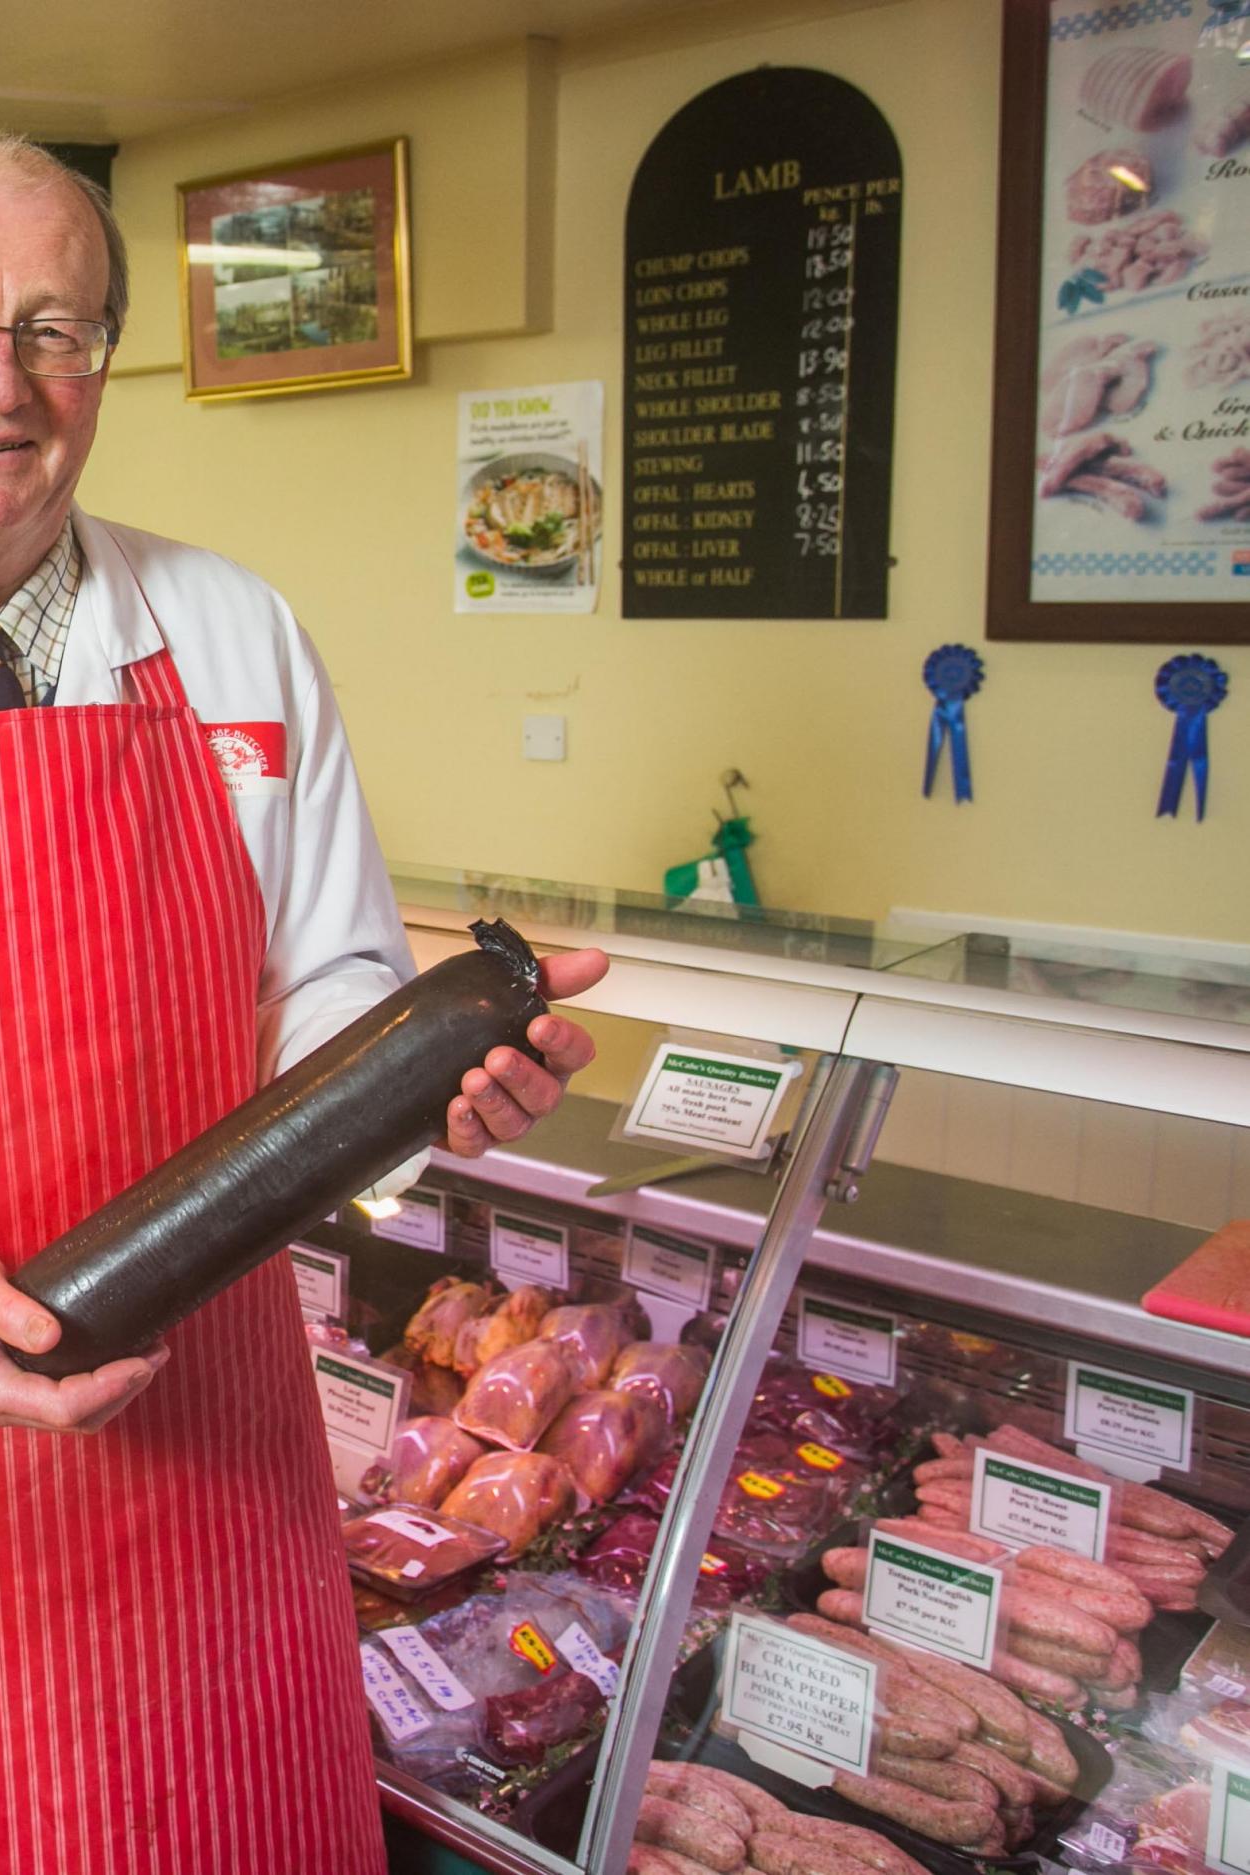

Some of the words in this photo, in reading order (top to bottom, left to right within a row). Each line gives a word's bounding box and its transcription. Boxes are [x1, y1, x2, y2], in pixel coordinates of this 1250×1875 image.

[714, 159, 800, 201] LAMB
[802, 185, 859, 207] PENCE
[865, 178, 901, 197] PER
[635, 313, 692, 336] WHOLE
[696, 307, 730, 329] LEG
[635, 343, 667, 364] LEG
[669, 337, 726, 359] FILLET
[681, 364, 738, 388] FILLET
[634, 398, 689, 419] WHOLE
[693, 390, 782, 414] SHOULDER
[634, 426, 716, 449] SHOULDER
[719, 420, 775, 443] BLADE
[634, 454, 704, 477] STEWING
[692, 509, 756, 531] KIDNEY
[692, 538, 742, 559] LIVER
[633, 568, 689, 588] WHOLE
[686, 1077, 742, 1096] SAUSAGES
[707, 1064, 738, 1083] Quality
[683, 1088, 707, 1098] made
[708, 1091, 729, 1102] here
[730, 1096, 753, 1107] from
[682, 1108, 707, 1121] Meat
[1009, 1496, 1031, 1511] Pork
[1032, 1503, 1069, 1522] Sausage
[897, 1583, 920, 1598] Pork
[921, 1590, 959, 1611] Sausage
[918, 1576, 936, 1593] Old
[937, 1580, 973, 1605] English
[939, 1615, 957, 1629] KG
[761, 1648, 841, 1689] CRACKED
[740, 1660, 794, 1693] BLACK
[798, 1682, 861, 1715] PEPPER
[750, 1681, 786, 1703] PORK
[788, 1691, 847, 1726] SAUSAGE
[767, 1711, 803, 1740] £7.95
[806, 1725, 825, 1748] kg
